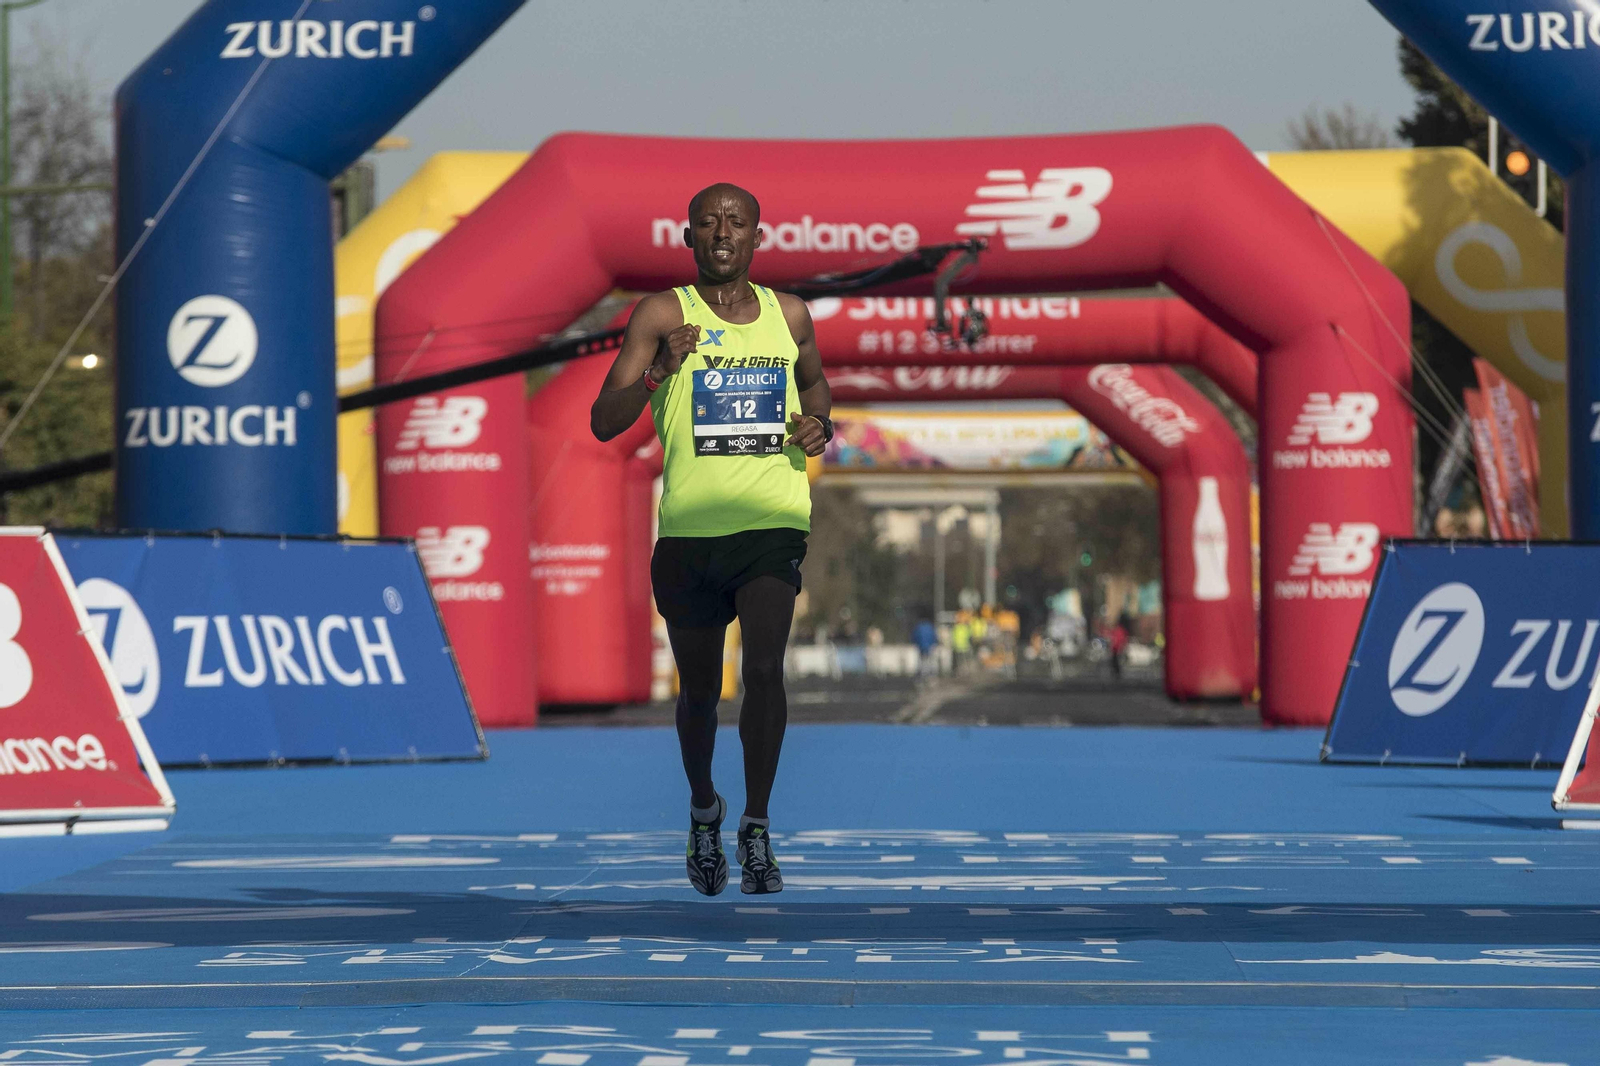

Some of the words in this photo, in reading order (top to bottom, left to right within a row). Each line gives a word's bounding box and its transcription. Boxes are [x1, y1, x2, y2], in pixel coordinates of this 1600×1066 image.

[219, 19, 416, 59] ZURICH
[726, 373, 777, 386] ZURICH
[732, 399, 757, 419] 12
[124, 404, 298, 448] ZURICH
[731, 425, 759, 433] REGASA
[1310, 445, 1391, 469] balance
[432, 579, 505, 602] alance
[1311, 575, 1372, 600] balan
[173, 614, 406, 688] ZURICH
[1491, 618, 1600, 691] ZU
[0, 733, 108, 775] lance
[7, 1024, 1155, 1044] ZURICH
